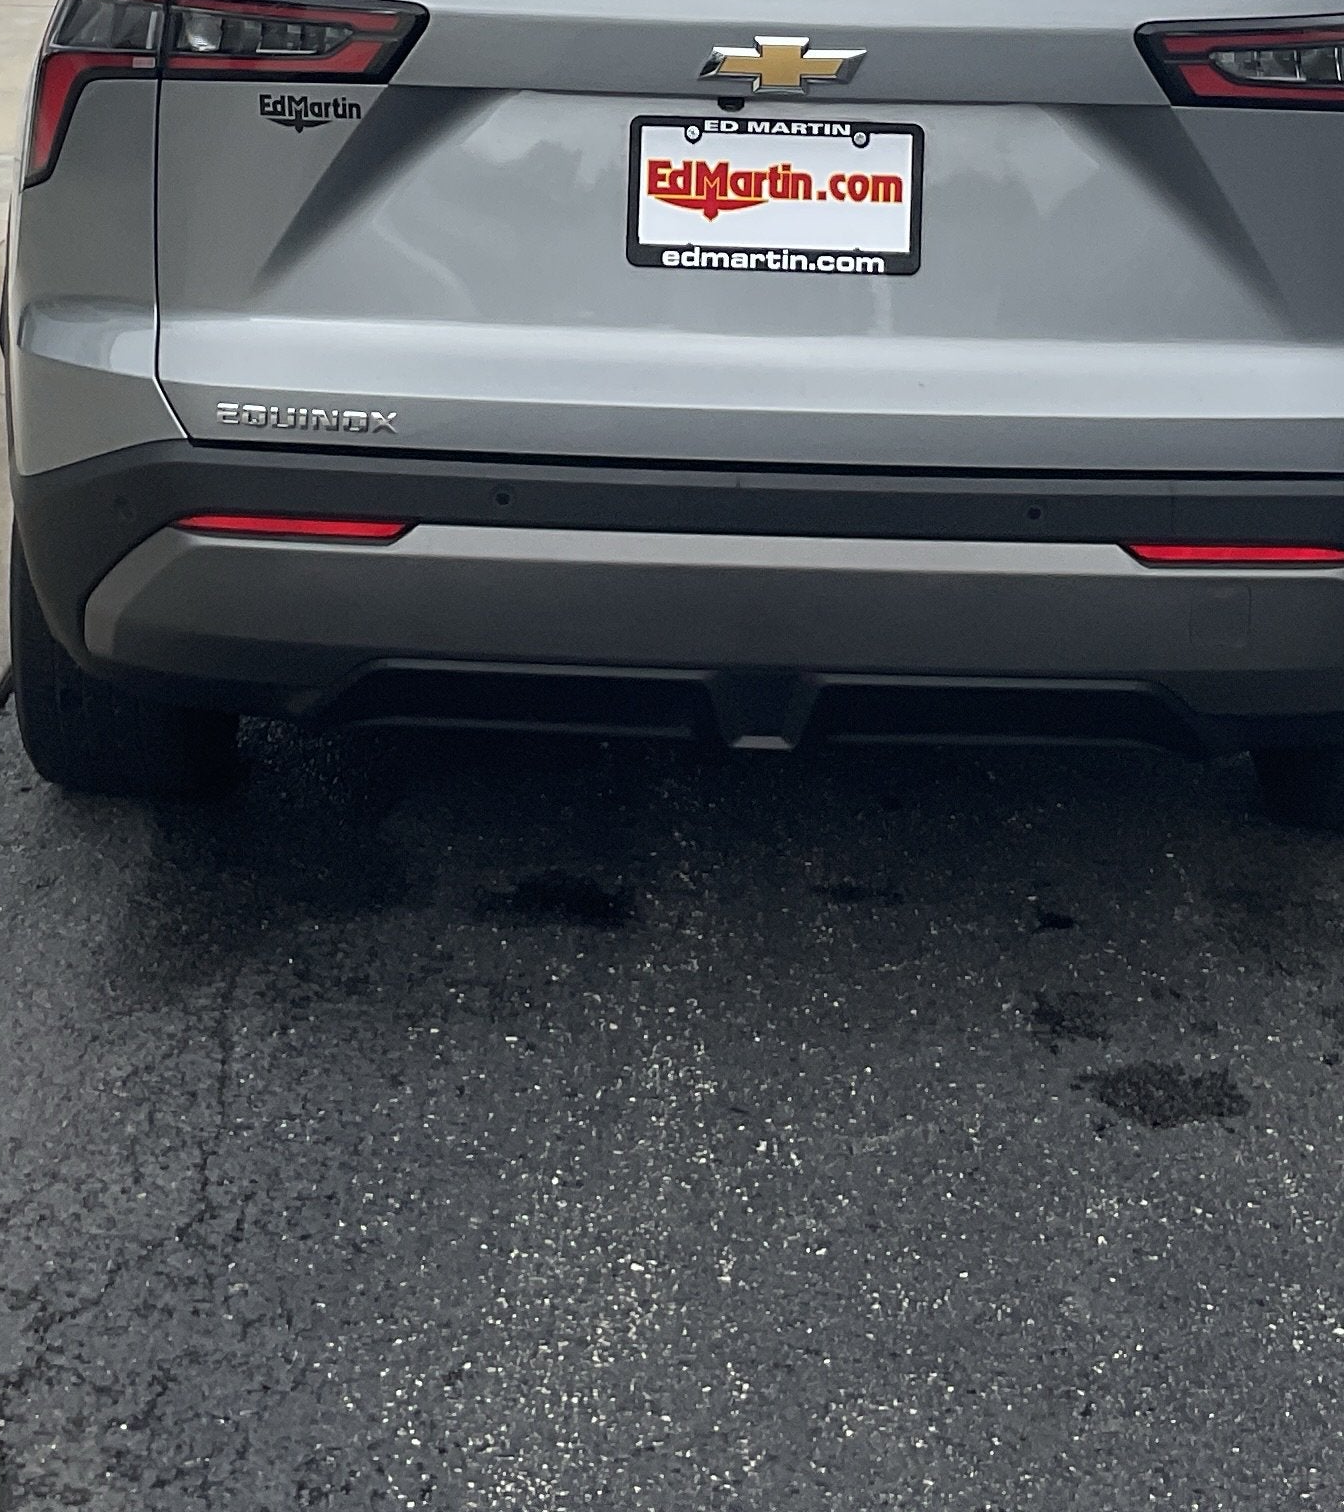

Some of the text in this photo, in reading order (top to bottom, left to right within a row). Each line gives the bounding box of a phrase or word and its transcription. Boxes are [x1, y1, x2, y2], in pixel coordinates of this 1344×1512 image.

[259, 94, 362, 120] EdMartin
[703, 119, 852, 136] ED MARTIN
[647, 159, 904, 204] EdMartin.com
[661, 246, 886, 274] edmartin.com
[216, 402, 398, 434] EQUINOX
